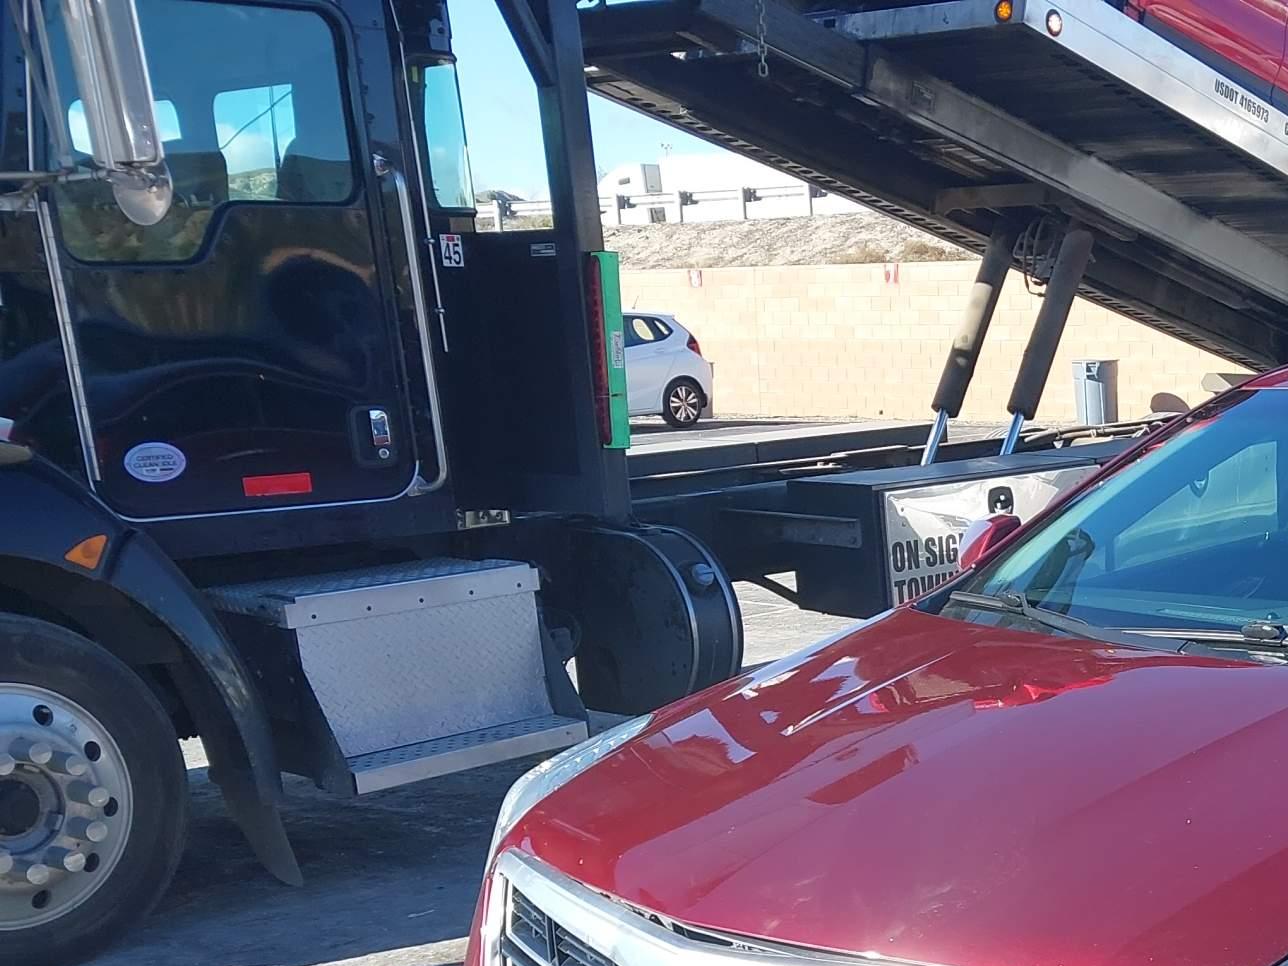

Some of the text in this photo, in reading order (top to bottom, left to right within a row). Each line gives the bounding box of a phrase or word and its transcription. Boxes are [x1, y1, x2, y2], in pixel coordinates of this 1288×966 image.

[1214, 78, 1269, 123] USDOT 4165973
[444, 242, 462, 265] 45
[892, 532, 964, 573] ON SIG
